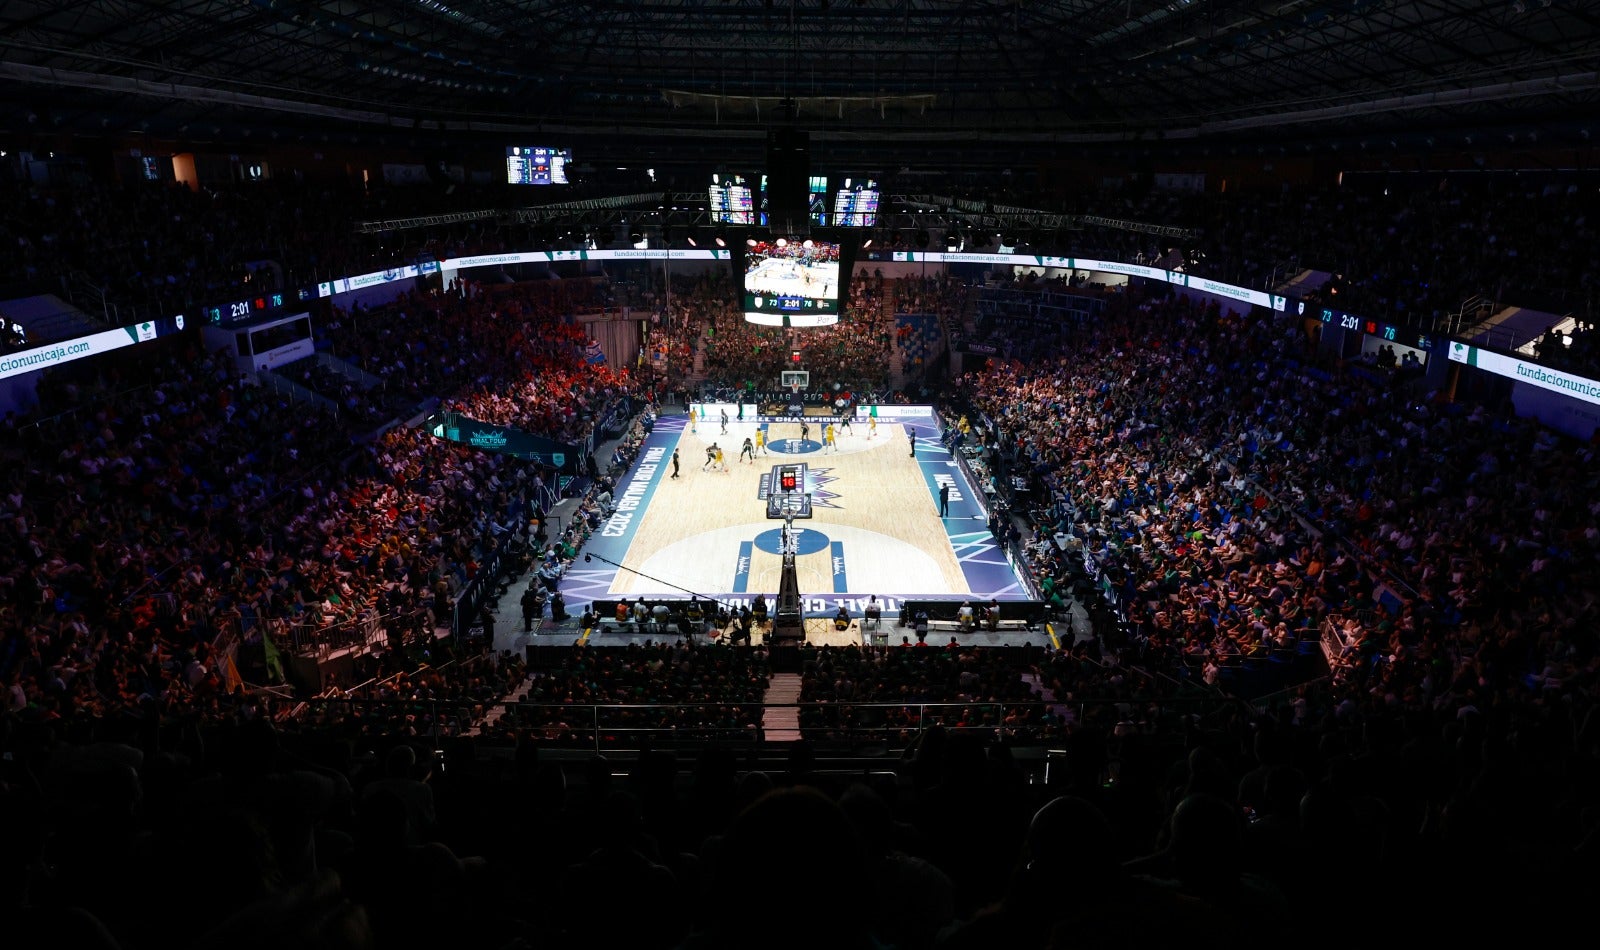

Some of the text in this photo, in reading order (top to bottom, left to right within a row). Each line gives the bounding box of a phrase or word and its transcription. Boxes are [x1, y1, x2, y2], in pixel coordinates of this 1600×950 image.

[614, 250, 685, 258] fundacionunicaj.com
[940, 253, 1010, 262] fundacionunicaja.com
[209, 308, 221, 322] 73
[231, 301, 250, 317] 2:01
[272, 295, 282, 307] 76
[1322, 310, 1332, 322] 73
[1341, 314, 1359, 331] 2:01
[1384, 327, 1395, 340] 76
[0, 341, 90, 373] cionunicaja.com
[757, 393, 791, 401] MALAG
[782, 478, 794, 486] 16
[601, 447, 667, 537] FINAL FOUR MALAGA 2023
